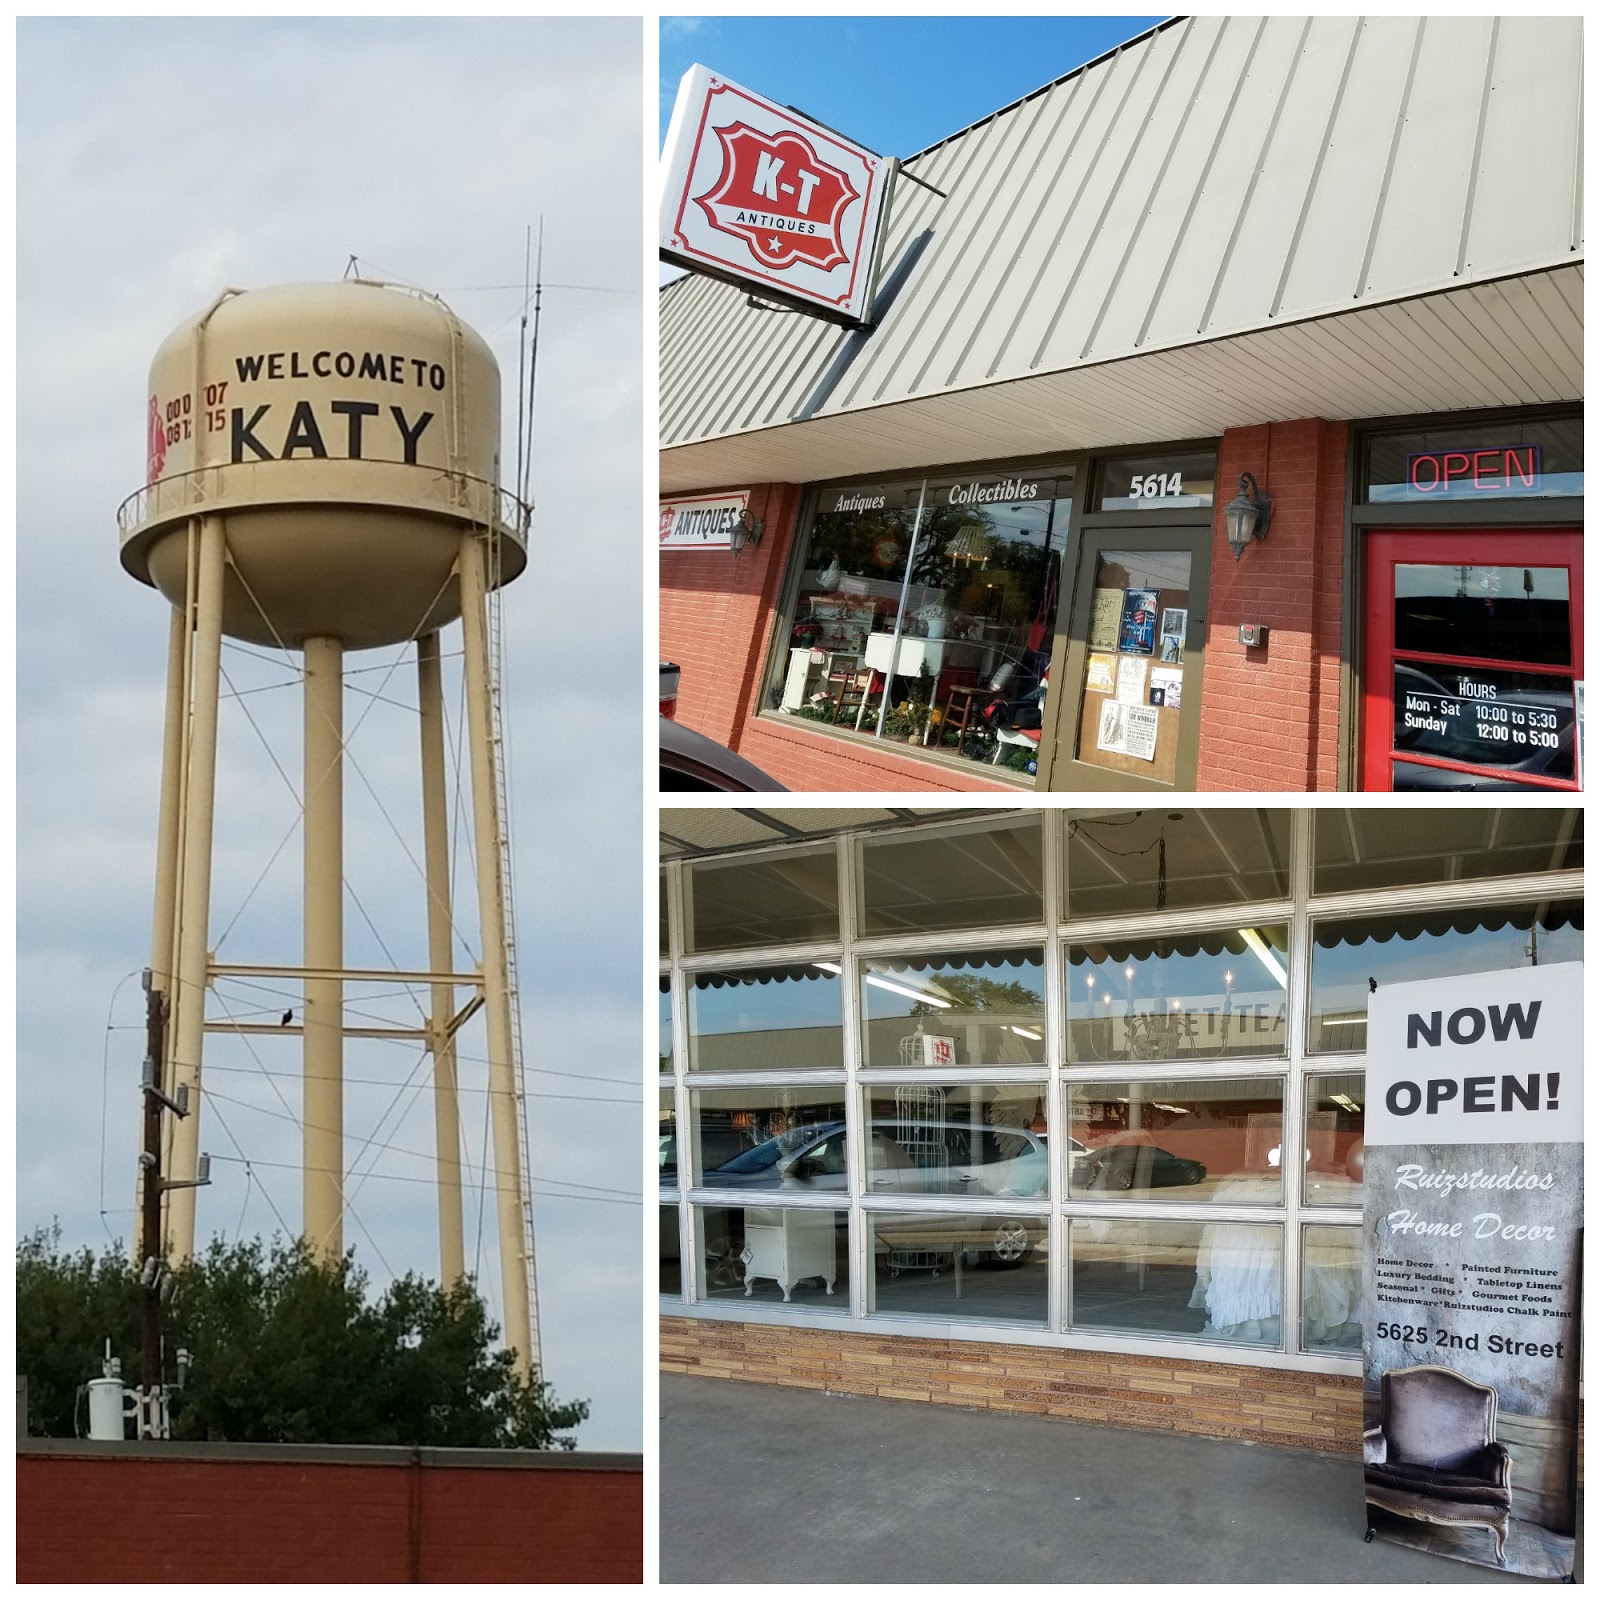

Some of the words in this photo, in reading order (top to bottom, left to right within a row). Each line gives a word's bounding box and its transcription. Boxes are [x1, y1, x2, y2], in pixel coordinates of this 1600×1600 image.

[752, 150, 820, 215] K-T
[736, 211, 816, 234] ANTIQUES
[235, 351, 404, 382] WELCOME
[411, 359, 445, 391] TO
[231, 401, 434, 465] KATY
[1129, 472, 1183, 499] 5614
[1411, 448, 1535, 493] OPEN
[835, 493, 886, 514] Antiques
[948, 478, 1038, 505] Collectibles
[674, 507, 736, 540] ANTIQUES
[1459, 682, 1497, 700] HOURS
[1406, 696, 1430, 712] Mon
[1440, 701, 1461, 716] Sat
[1475, 705, 1508, 722] 10:00
[1511, 711, 1525, 725] to
[1528, 713, 1557, 729] 5:30
[1404, 713, 1447, 736] Sunday
[1477, 724, 1509, 741] 12:00
[1512, 729, 1526, 743] to
[1529, 732, 1559, 748] 5:00
[1407, 1000, 1542, 1049] NOW
[1385, 1072, 1560, 1116] OPEN!
[1394, 1164, 1555, 1198] Ruizstudios
[1387, 1210, 1464, 1239] Home
[1472, 1212, 1557, 1241] Decor
[1377, 1258, 1403, 1267] Home
[1406, 1259, 1434, 1269] Decor
[1461, 1264, 1501, 1274] Painted
[1503, 1266, 1558, 1277] Furniture
[1377, 1270, 1412, 1280] Luxury
[1414, 1272, 1455, 1284] Bedding
[1477, 1278, 1523, 1290] Tabletop
[1526, 1281, 1563, 1291] Linens
[1377, 1282, 1418, 1293] Seasonal
[1431, 1286, 1455, 1296] Gifts
[1472, 1290, 1519, 1302] Gourmet
[1521, 1294, 1553, 1303] Foods
[1507, 1306, 1540, 1316] Chalk
[1542, 1309, 1573, 1319] Paint
[1377, 1322, 1428, 1344] 5625
[1435, 1329, 1479, 1351] 2nd
[1487, 1334, 1564, 1359] Street
